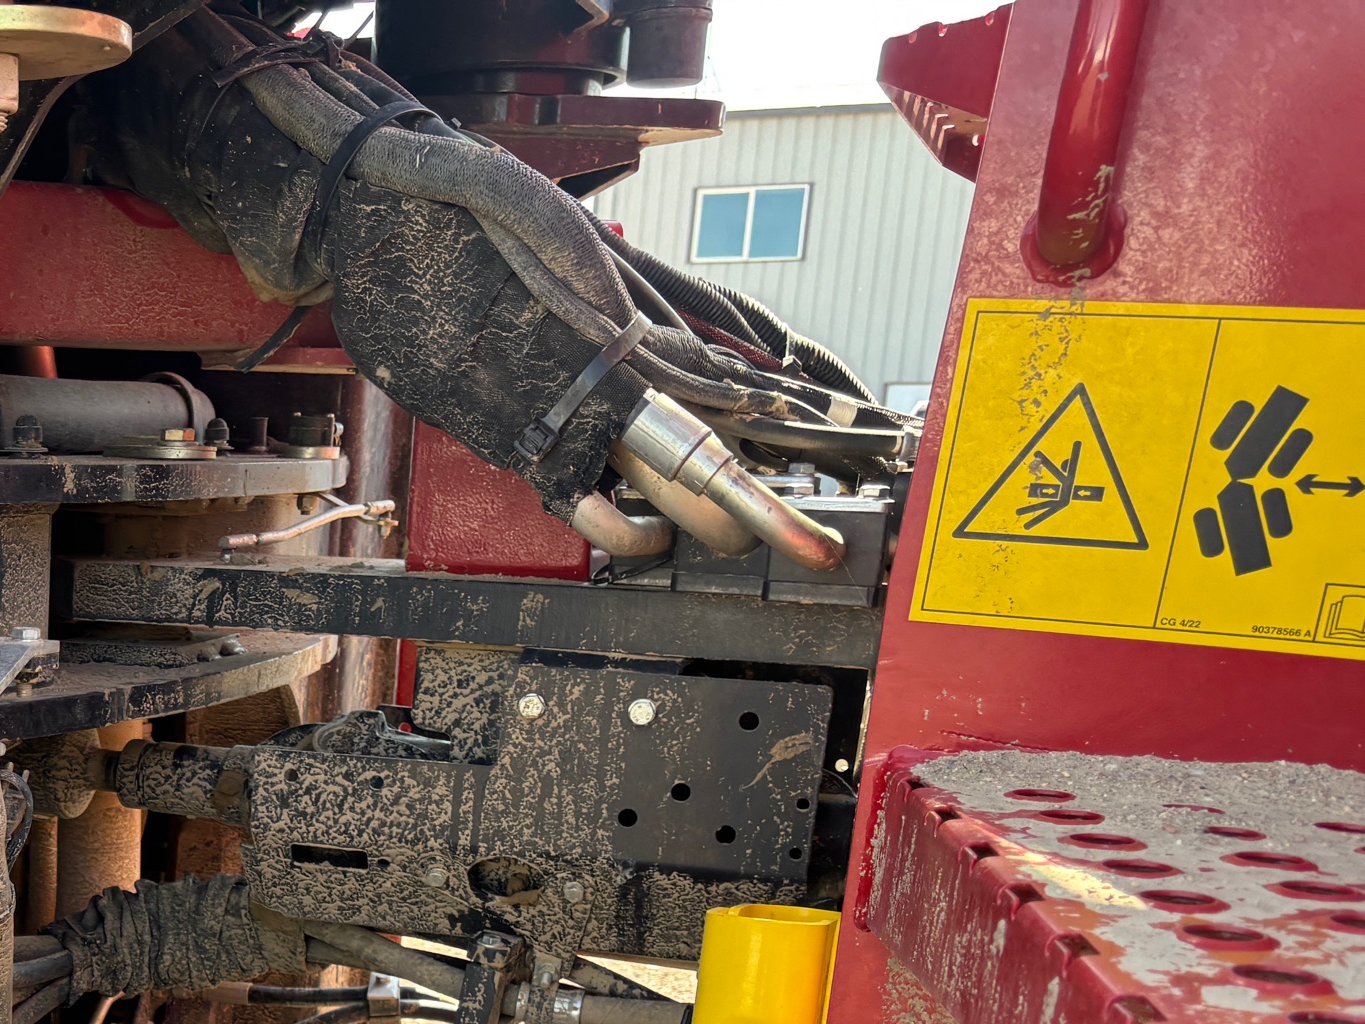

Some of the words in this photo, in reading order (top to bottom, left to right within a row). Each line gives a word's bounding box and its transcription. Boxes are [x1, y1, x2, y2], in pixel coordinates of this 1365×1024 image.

[1160, 617, 1177, 627] CG
[1179, 619, 1201, 629] 4/22
[1251, 624, 1302, 637] 90378566
[1303, 629, 1312, 638] A
